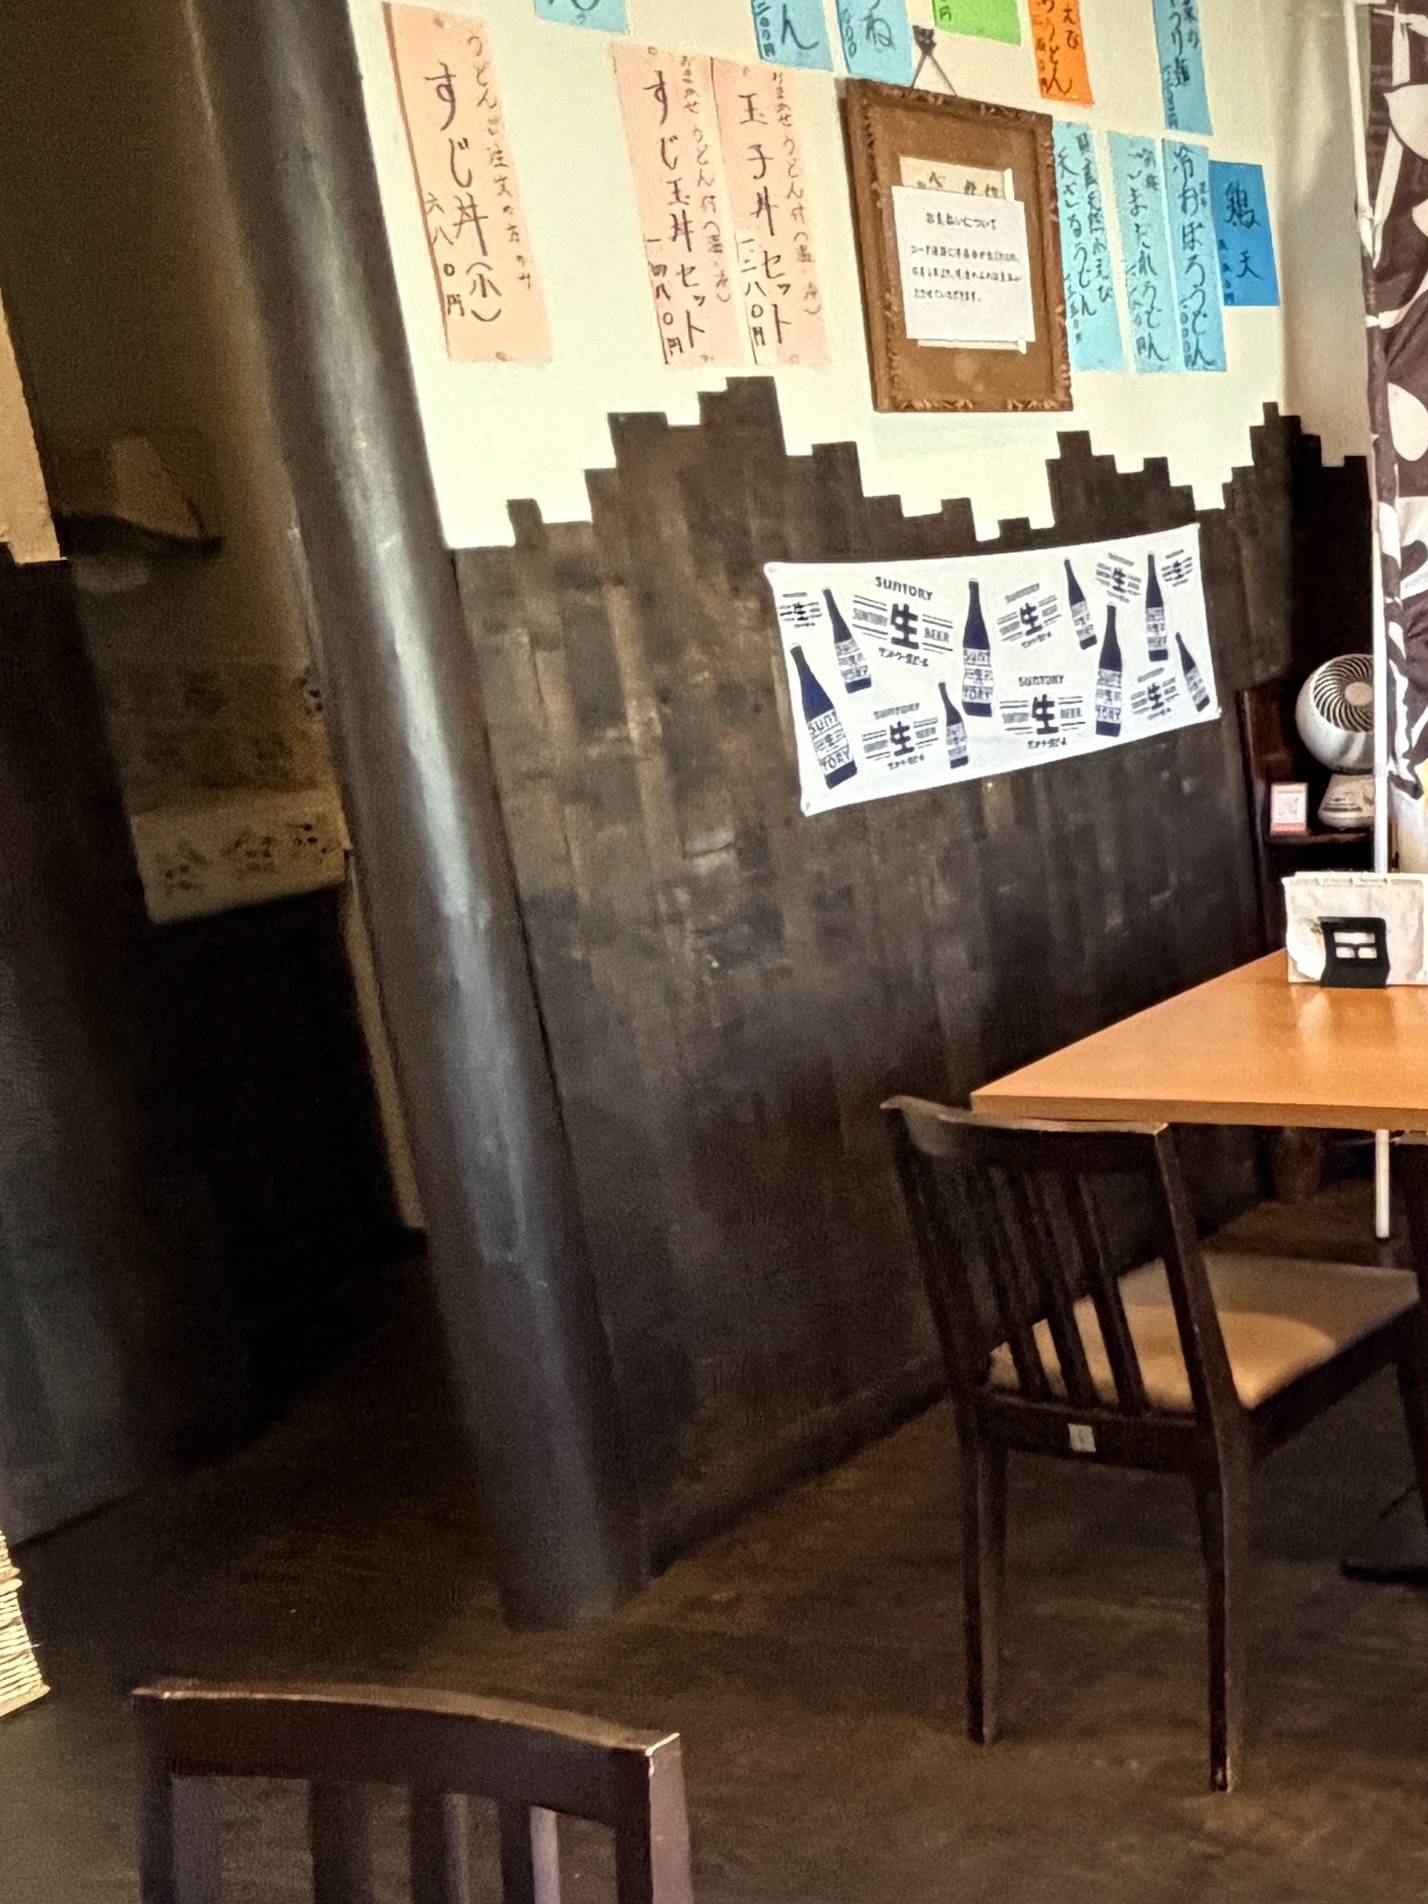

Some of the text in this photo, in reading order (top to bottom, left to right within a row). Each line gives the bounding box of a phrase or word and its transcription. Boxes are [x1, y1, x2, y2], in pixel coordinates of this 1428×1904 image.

[737, 92, 792, 345] 玉子丼セット
[875, 576, 933, 601] SUNTORY
